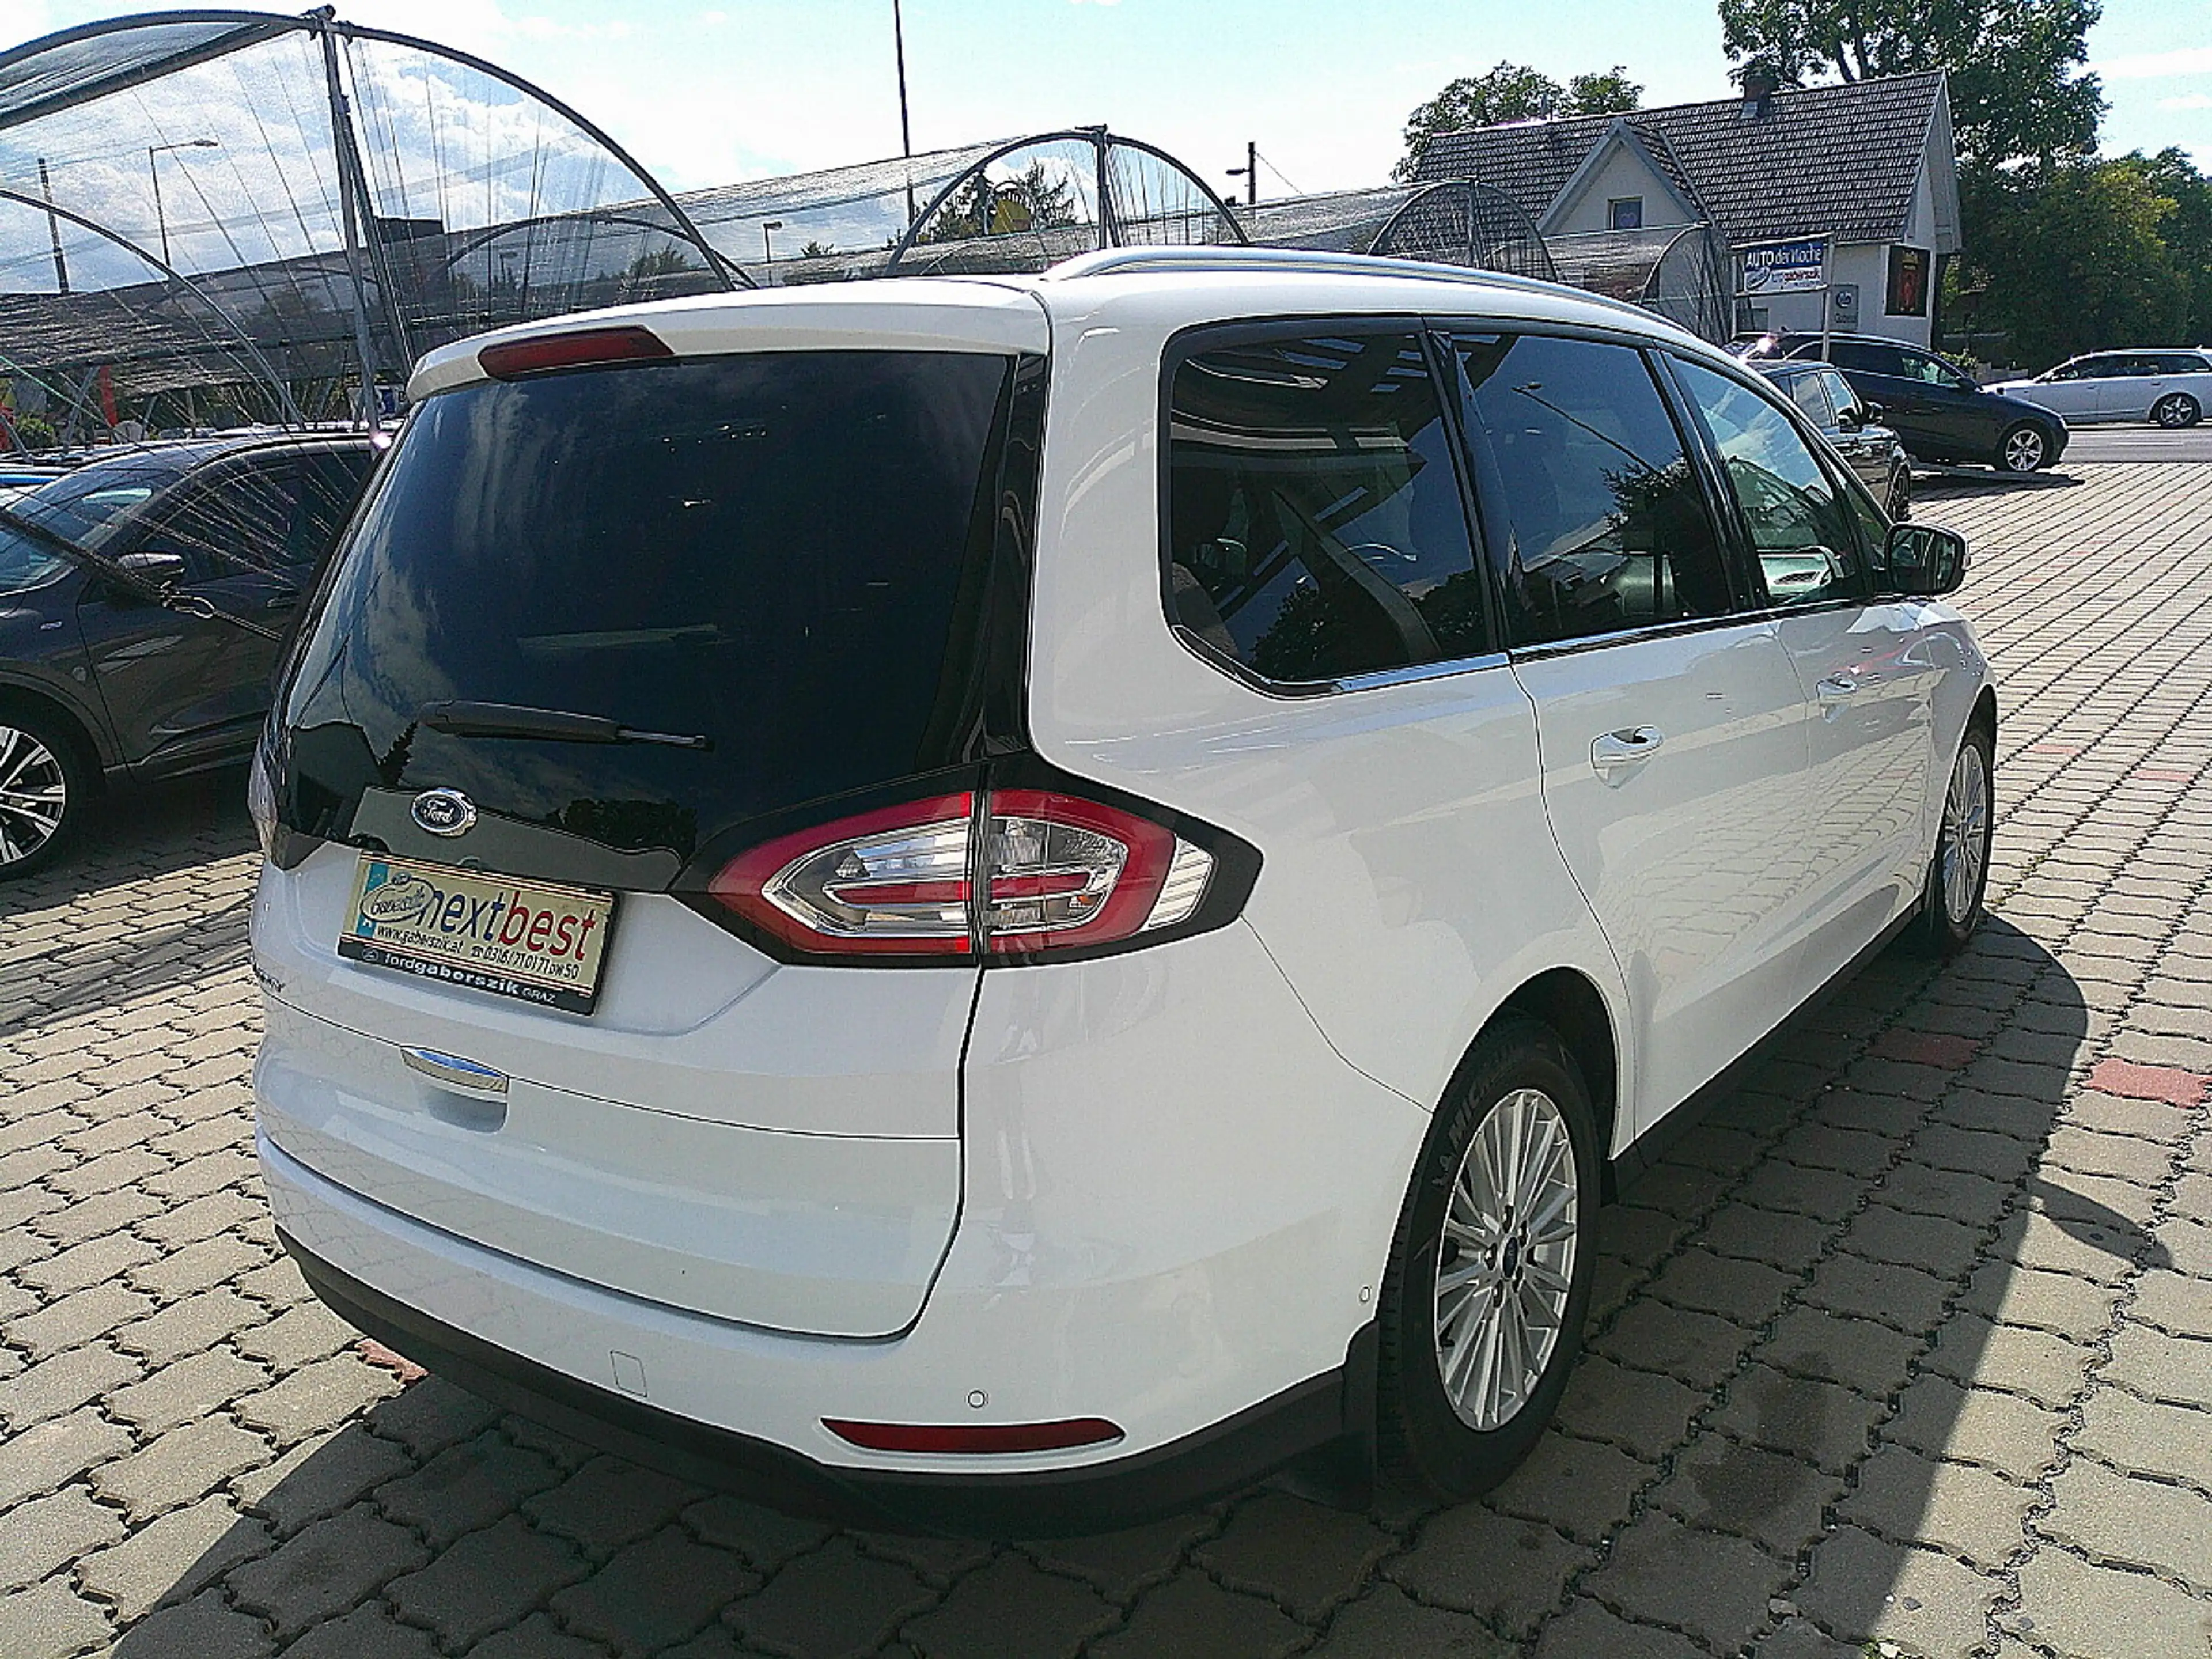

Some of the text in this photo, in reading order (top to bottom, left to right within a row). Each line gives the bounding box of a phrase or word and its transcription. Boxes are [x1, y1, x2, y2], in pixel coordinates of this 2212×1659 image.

[1745, 250, 1775, 267] AUTO
[421, 799, 455, 823] Ford
[415, 890, 597, 961] nextbest
[521, 988, 556, 1005] GRAZ
